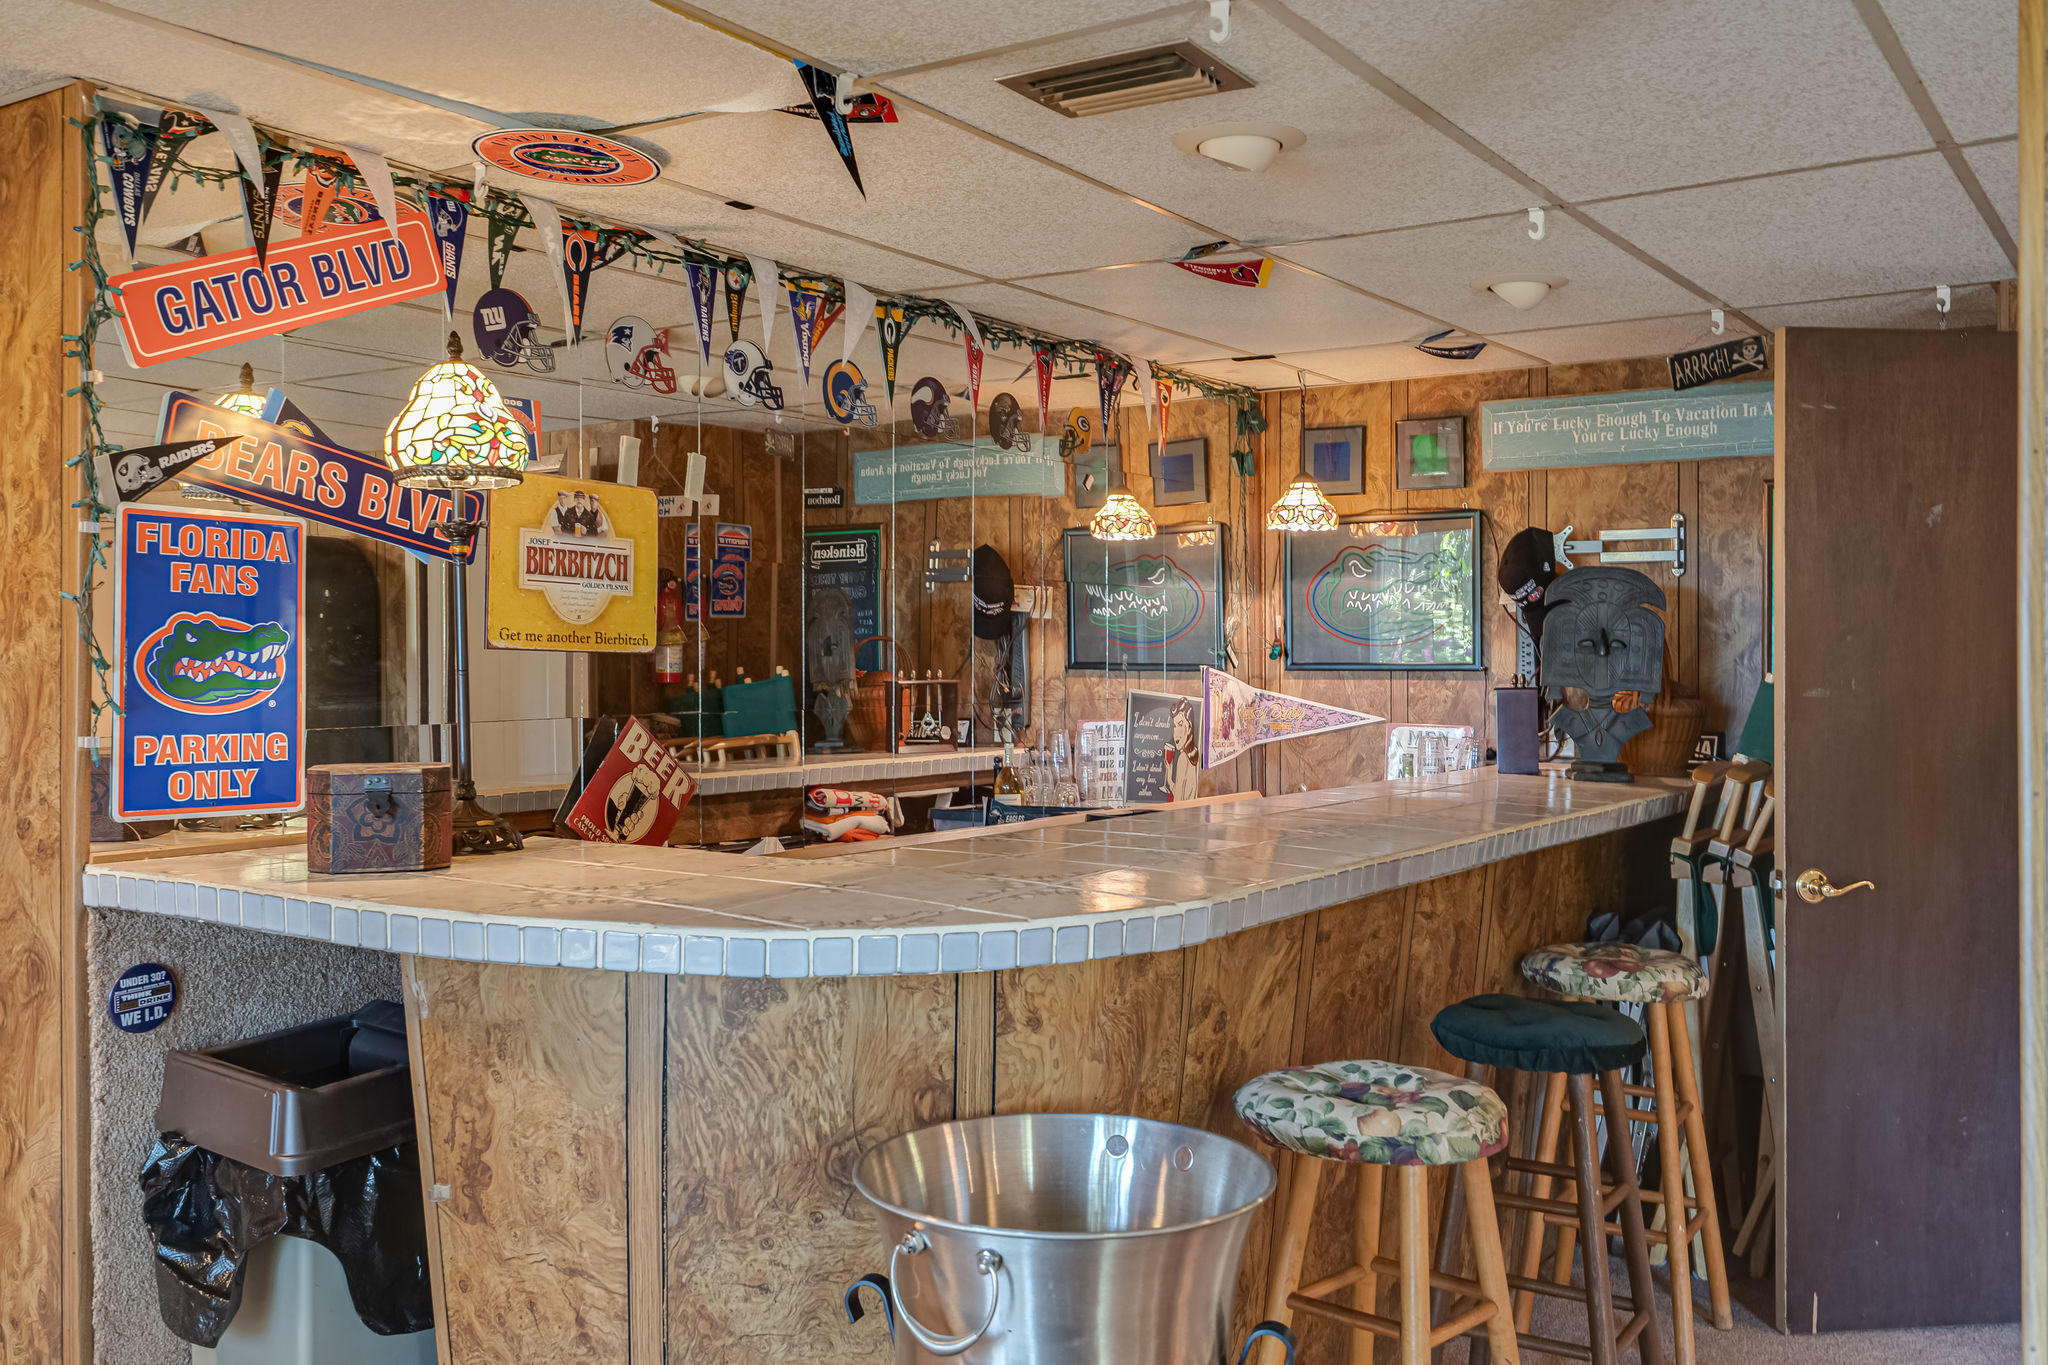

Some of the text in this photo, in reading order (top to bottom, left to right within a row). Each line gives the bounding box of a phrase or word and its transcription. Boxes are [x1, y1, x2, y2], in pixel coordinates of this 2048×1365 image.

[122, 172, 136, 227] COWBOYS
[446, 241, 456, 280] GIANTS
[154, 238, 412, 336] GATOR BLVD
[572, 273, 581, 326] BEARS
[700, 304, 710, 343] RAVENS
[887, 347, 895, 381] PACKERS
[1674, 348, 1732, 388] ARRRGH!
[1493, 420, 1503, 435] If
[1507, 419, 1548, 434] You're
[1553, 417, 1592, 433] Lucky
[1597, 412, 1647, 428] Enough
[1652, 409, 1671, 423] To
[1676, 404, 1738, 421] Vacation
[1742, 402, 1757, 417] In
[1572, 421, 1718, 445] You're Lucky Enough
[157, 439, 217, 469] RAIDERS
[193, 418, 349, 509] BEARS
[136, 521, 290, 563] FLORIDA
[528, 537, 551, 546] JOSEF
[170, 561, 259, 597] FANS
[526, 545, 629, 582] BIERBITZCH
[581, 581, 629, 592] GOLDEN PILSNER
[499, 627, 649, 647] Get me another Bierbitzch
[133, 731, 289, 767] PARKING
[619, 721, 691, 811] BEER
[167, 767, 259, 802] ONLY
[581, 814, 602, 836] PROUD
[1005, 814, 1025, 823] EAGLES
[120, 970, 166, 988] UNDER 30?
[121, 990, 152, 1001] THINK
[139, 993, 170, 1005] DRINK
[121, 1006, 167, 1027] WE I.D.
